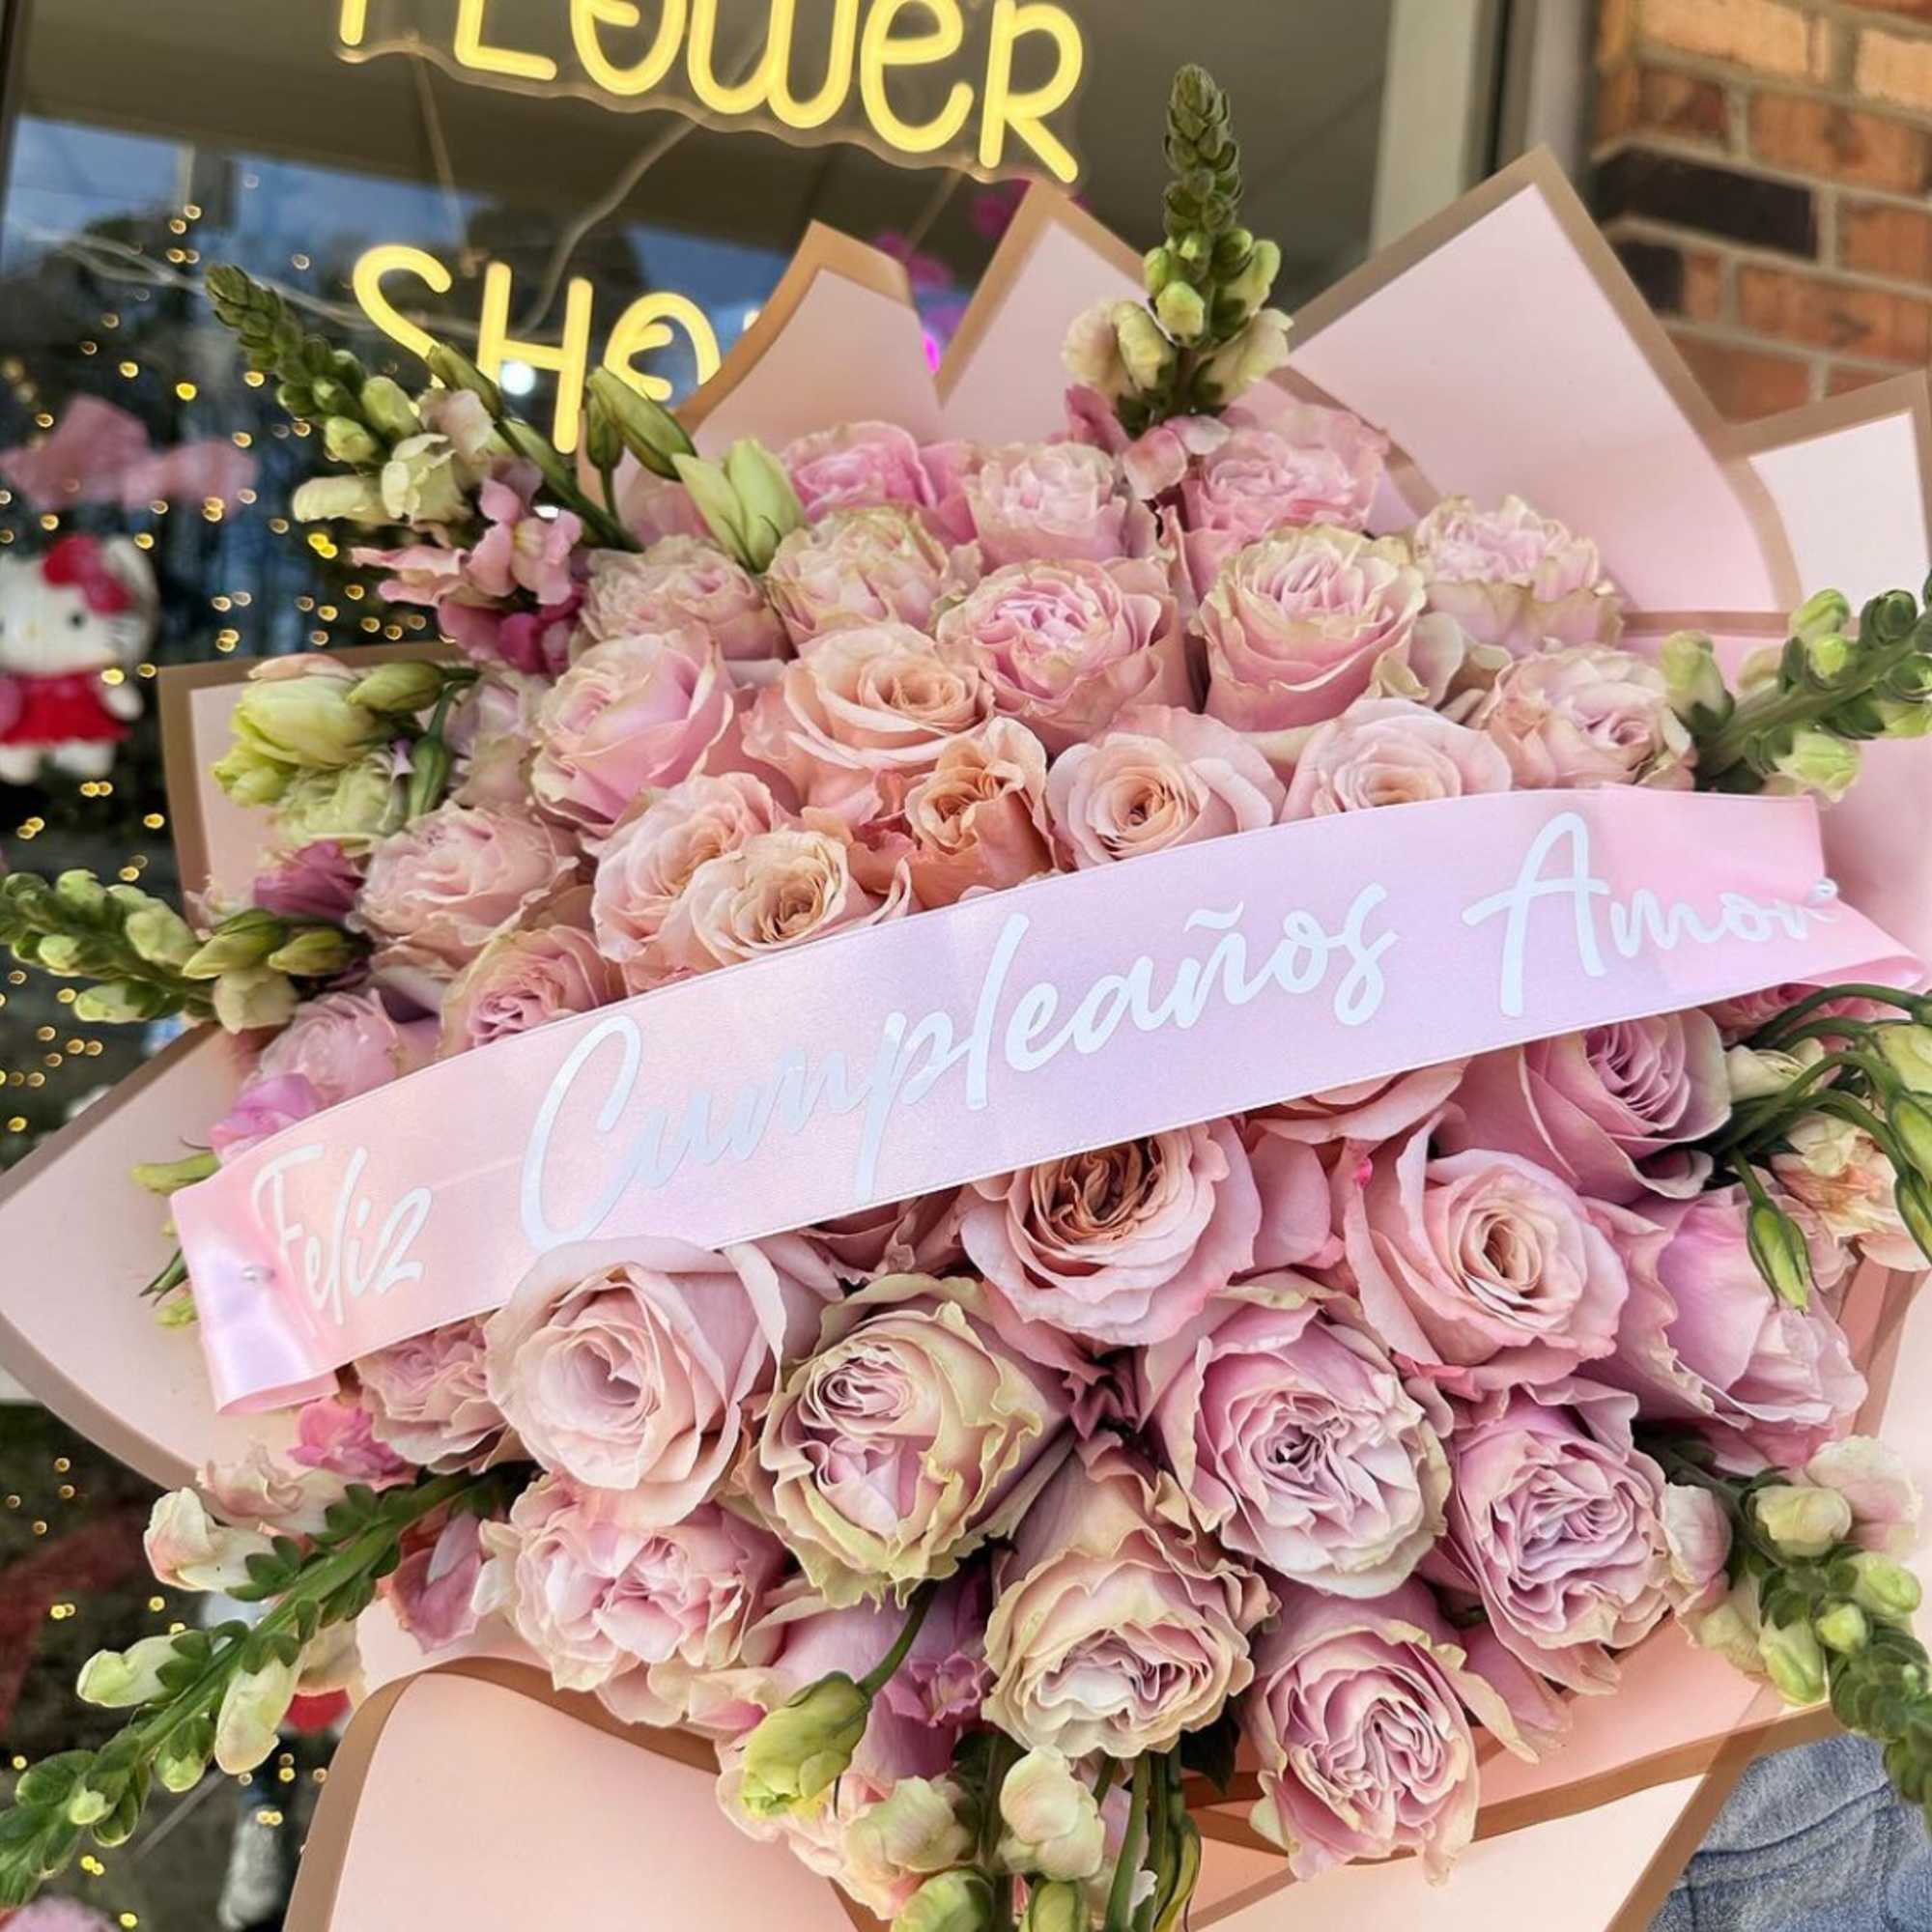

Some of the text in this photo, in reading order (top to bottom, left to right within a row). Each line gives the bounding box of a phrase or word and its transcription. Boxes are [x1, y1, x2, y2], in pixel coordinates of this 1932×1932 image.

[339, 0, 1083, 184] LOWER
[352, 244, 726, 455] SHO
[250, 810, 1837, 1331] Feliz Cumpleaños Amor
